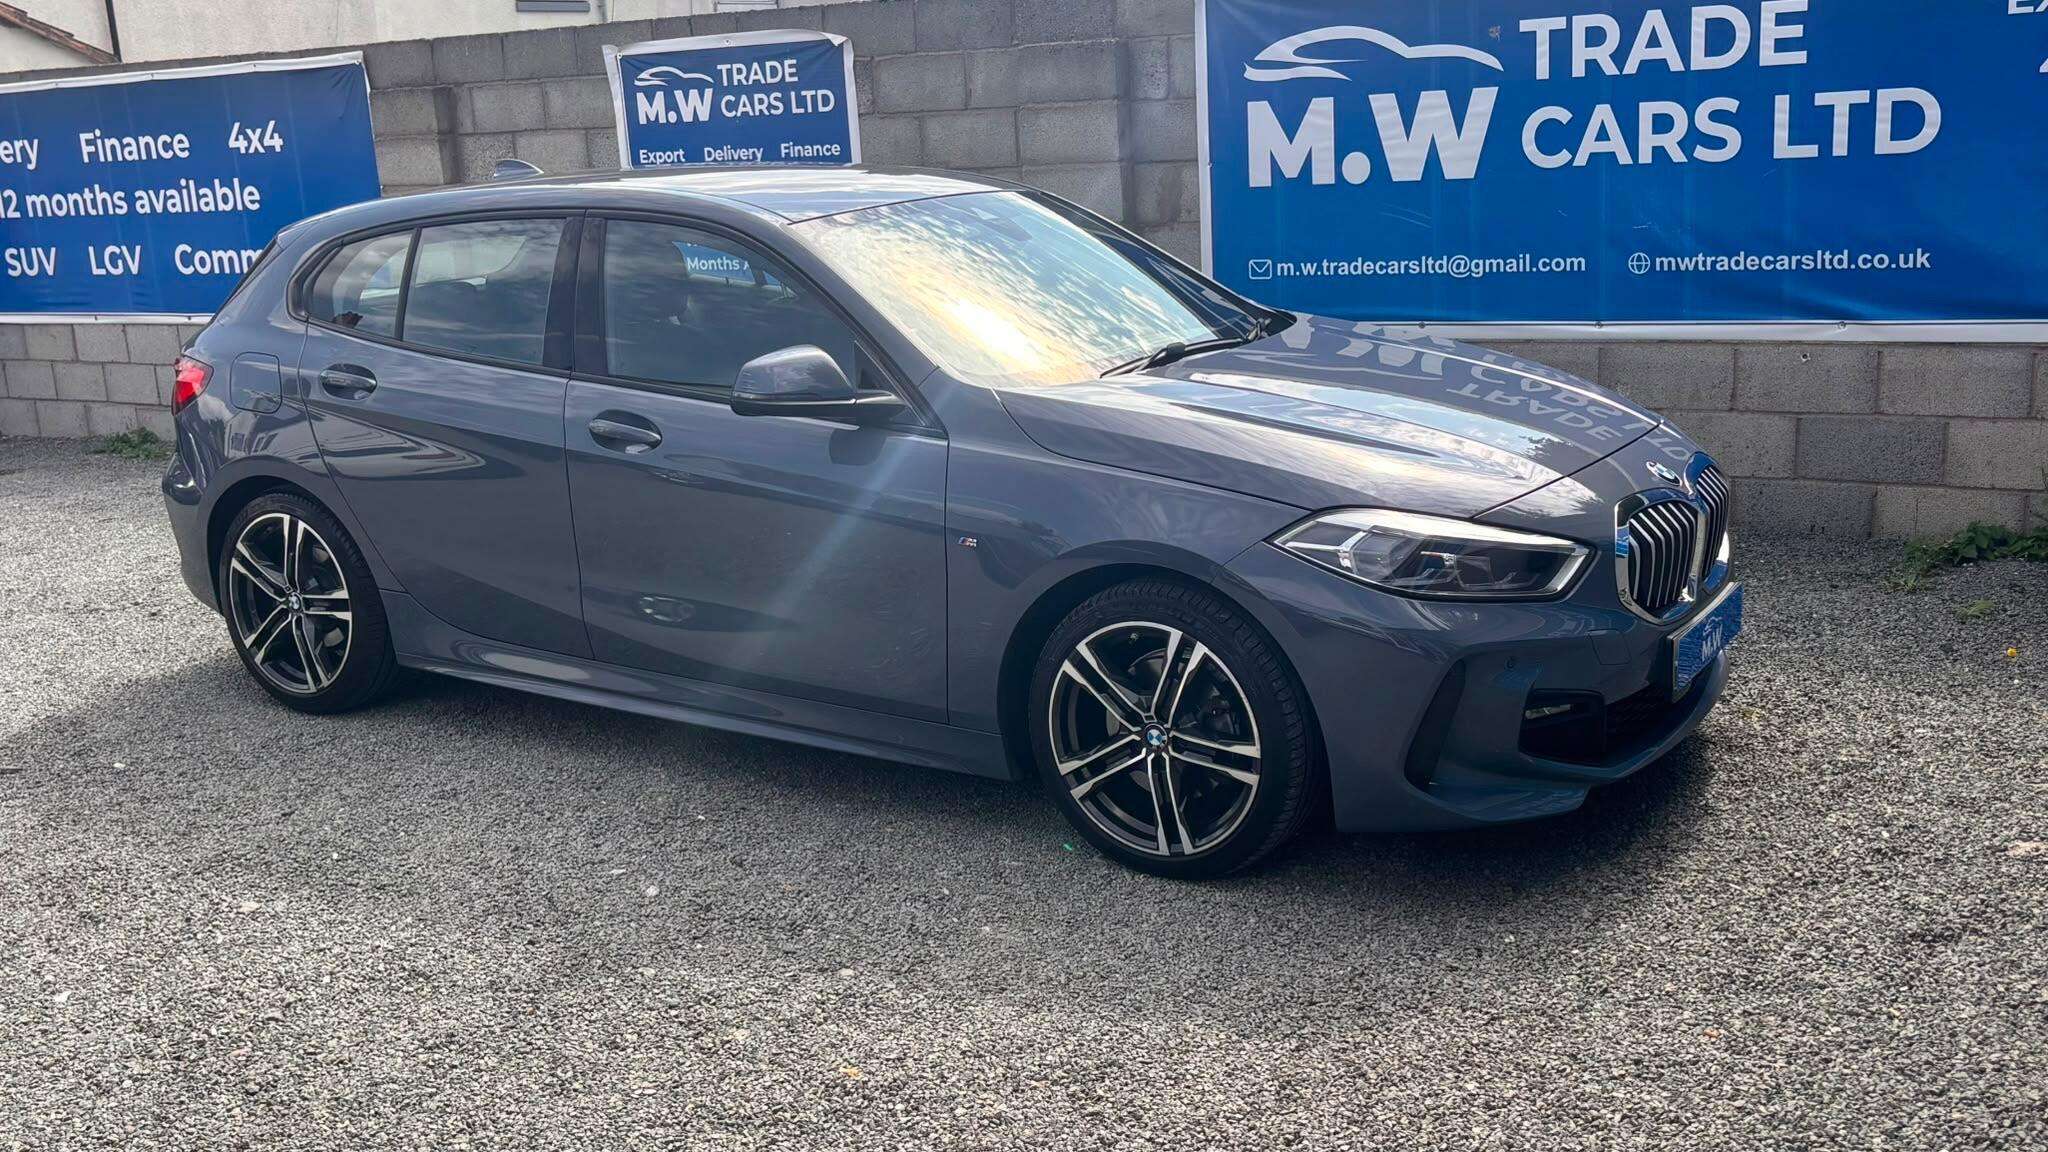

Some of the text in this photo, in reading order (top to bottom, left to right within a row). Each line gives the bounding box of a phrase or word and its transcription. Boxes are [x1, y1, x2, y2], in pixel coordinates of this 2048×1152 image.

[1519, 0, 1808, 80] TRADE
[717, 59, 798, 87] TRADE
[636, 88, 714, 125] M.W
[720, 89, 836, 117] CARS LTD
[79, 128, 190, 164] Finance
[228, 120, 284, 154] 4x4
[1246, 86, 1500, 188] M.W
[1521, 87, 1942, 169] CARS LTD
[640, 141, 841, 165] Export Delivery Finance
[25, 183, 128, 218] months
[134, 177, 261, 215] available
[4, 246, 57, 277] SUV
[88, 244, 142, 276] LGV
[687, 256, 740, 271] Months
[1277, 248, 1931, 278] m.w.tradecarsltd@gmail.com mwtradecarsltd.co.uk
